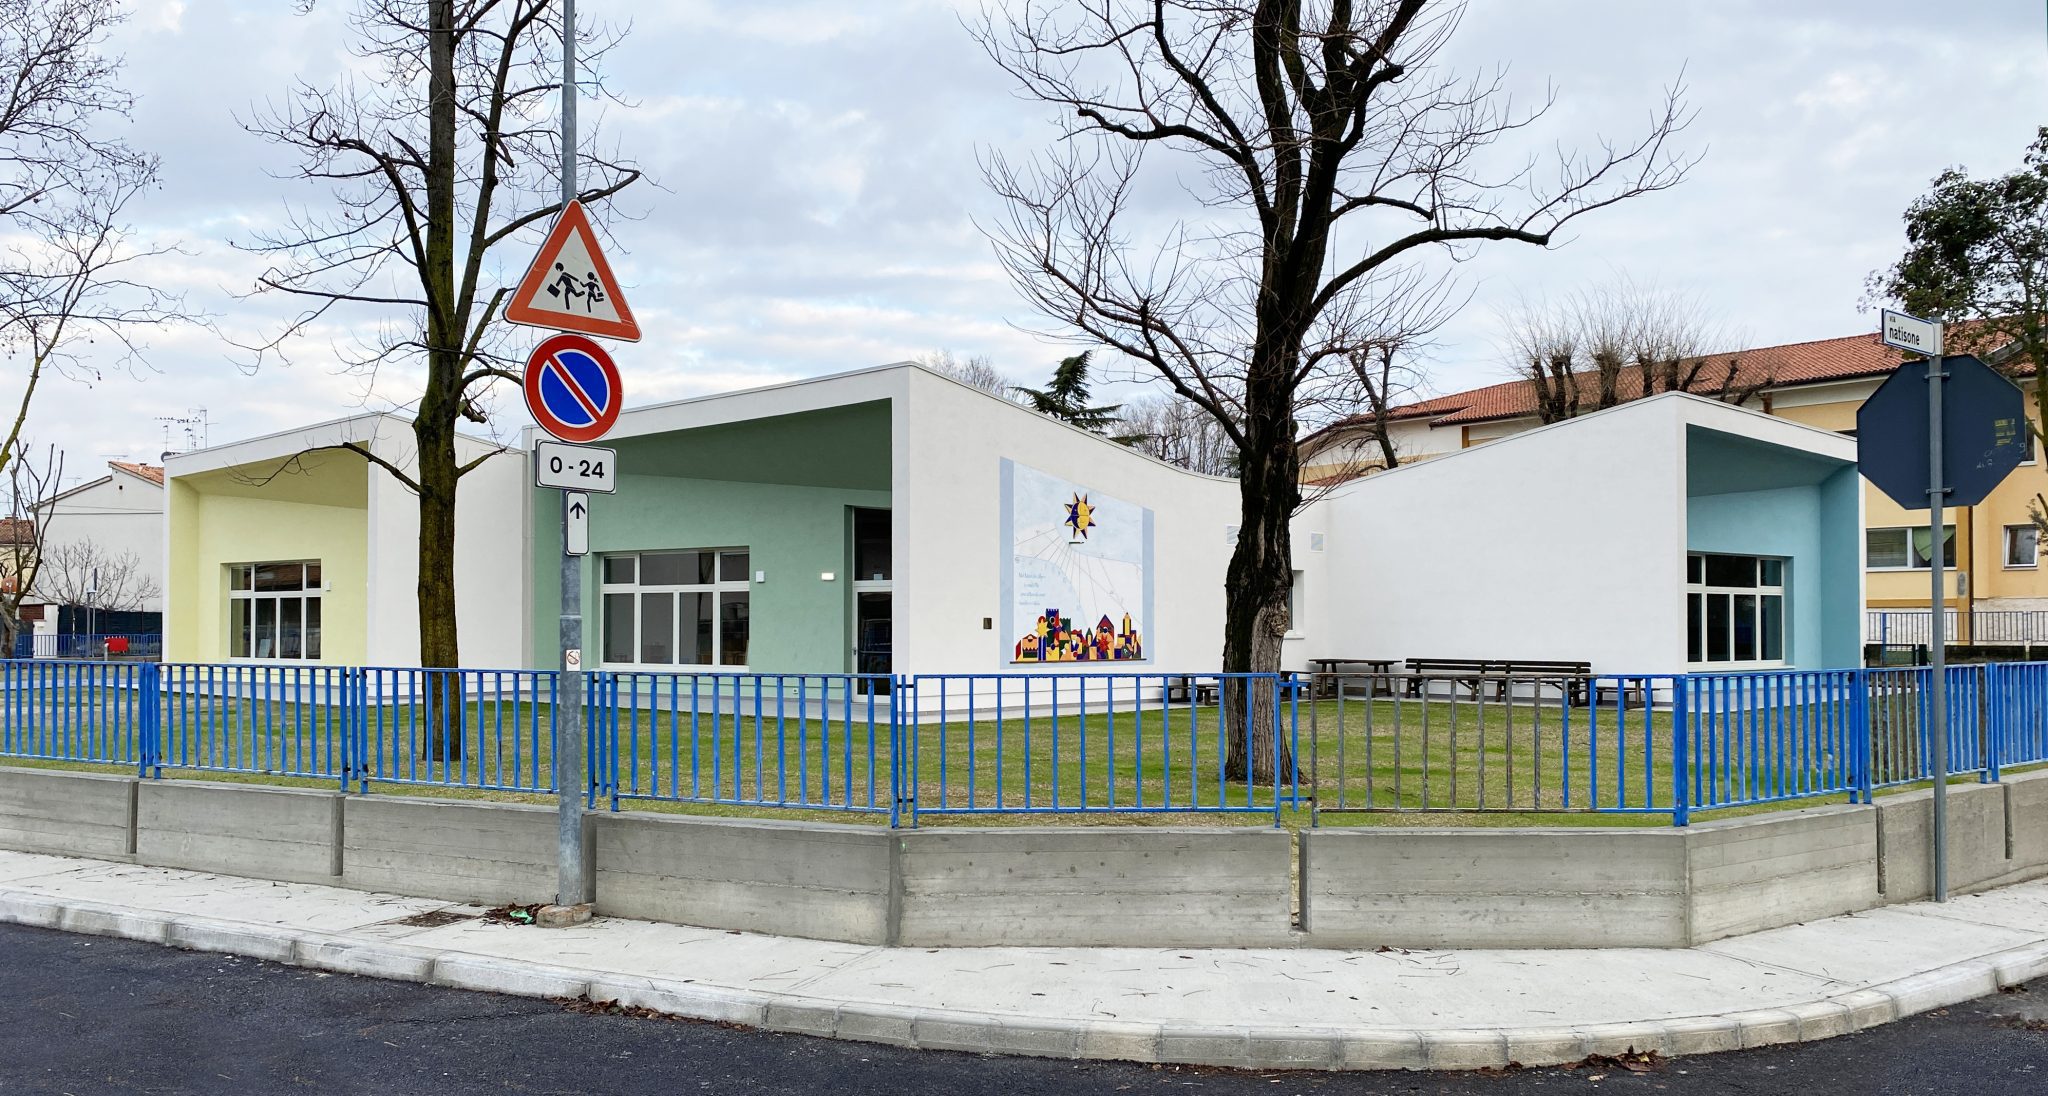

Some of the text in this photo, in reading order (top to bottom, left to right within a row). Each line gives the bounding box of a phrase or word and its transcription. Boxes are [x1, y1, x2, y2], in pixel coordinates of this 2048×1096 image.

[1889, 326, 1920, 345] natisone
[550, 456, 562, 474] 0
[579, 459, 605, 479] 24
